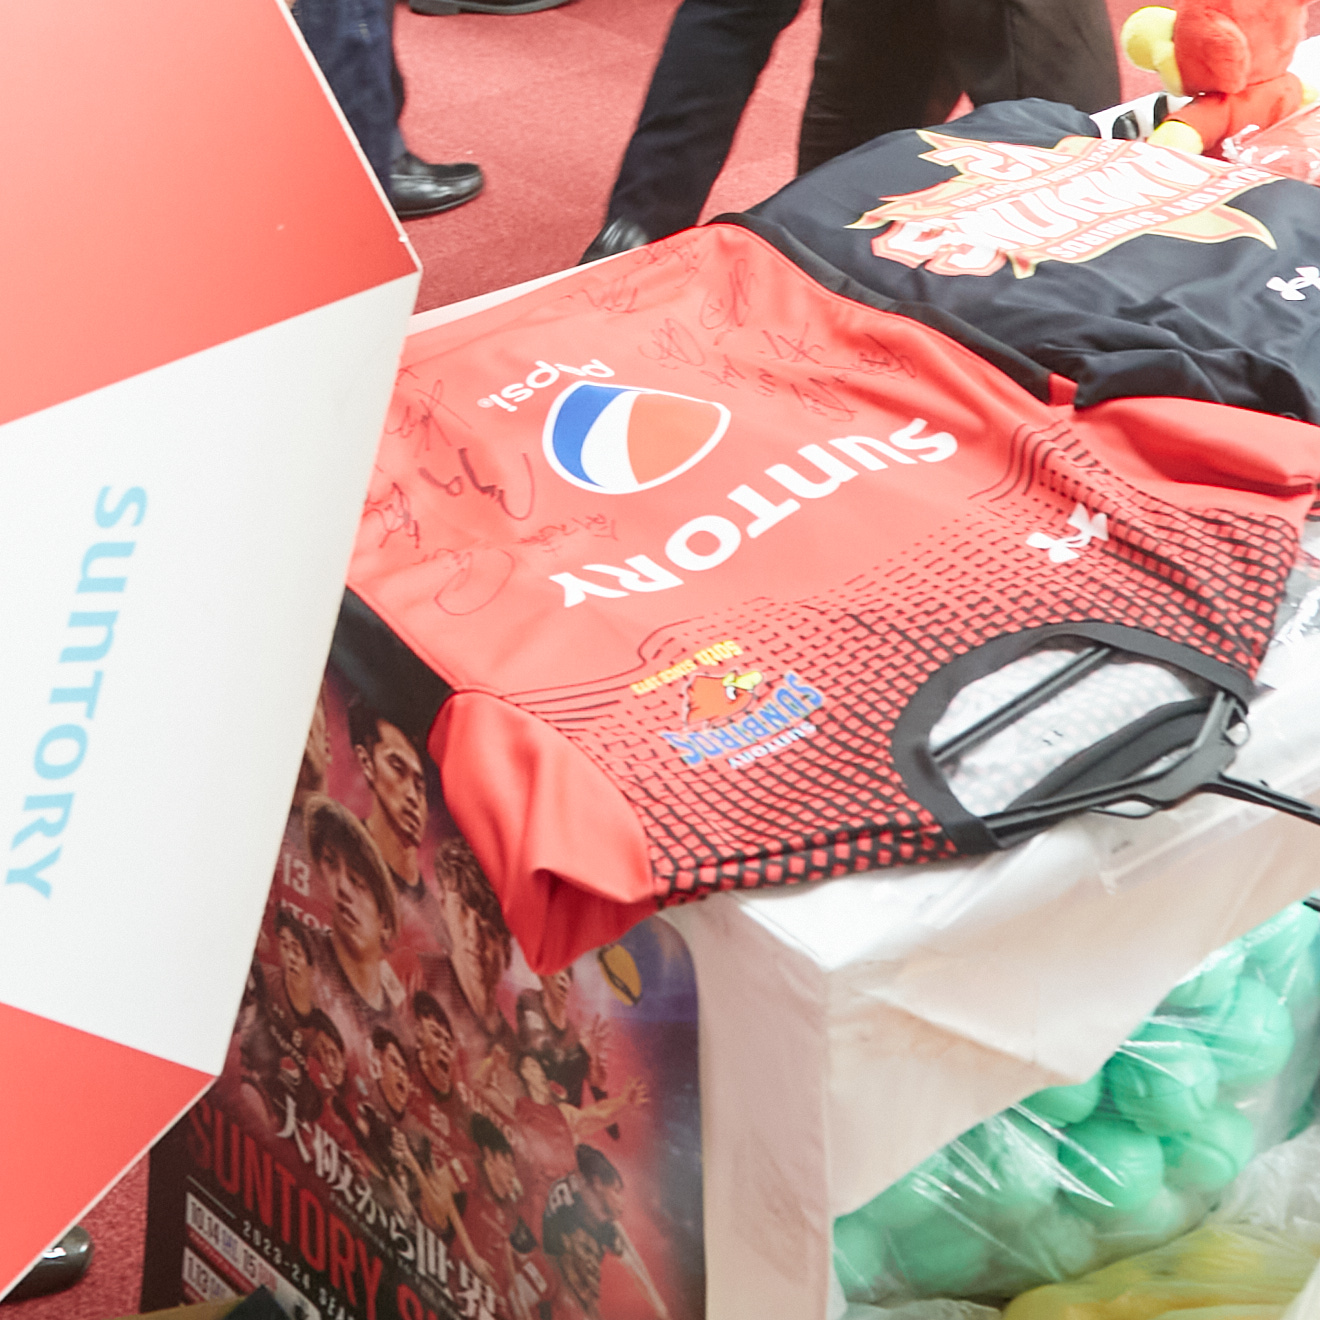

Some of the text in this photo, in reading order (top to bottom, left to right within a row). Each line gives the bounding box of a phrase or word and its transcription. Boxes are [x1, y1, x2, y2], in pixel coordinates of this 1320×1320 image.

[1046, 211, 1168, 259] SUNBIRDS
[549, 418, 958, 608] SUNTORY
[3, 484, 149, 899] SUNTORY
[659, 670, 825, 766] SUNBIRDS
[728, 721, 817, 769] SUNTORY
[186, 1098, 383, 1320] SUNTORY
